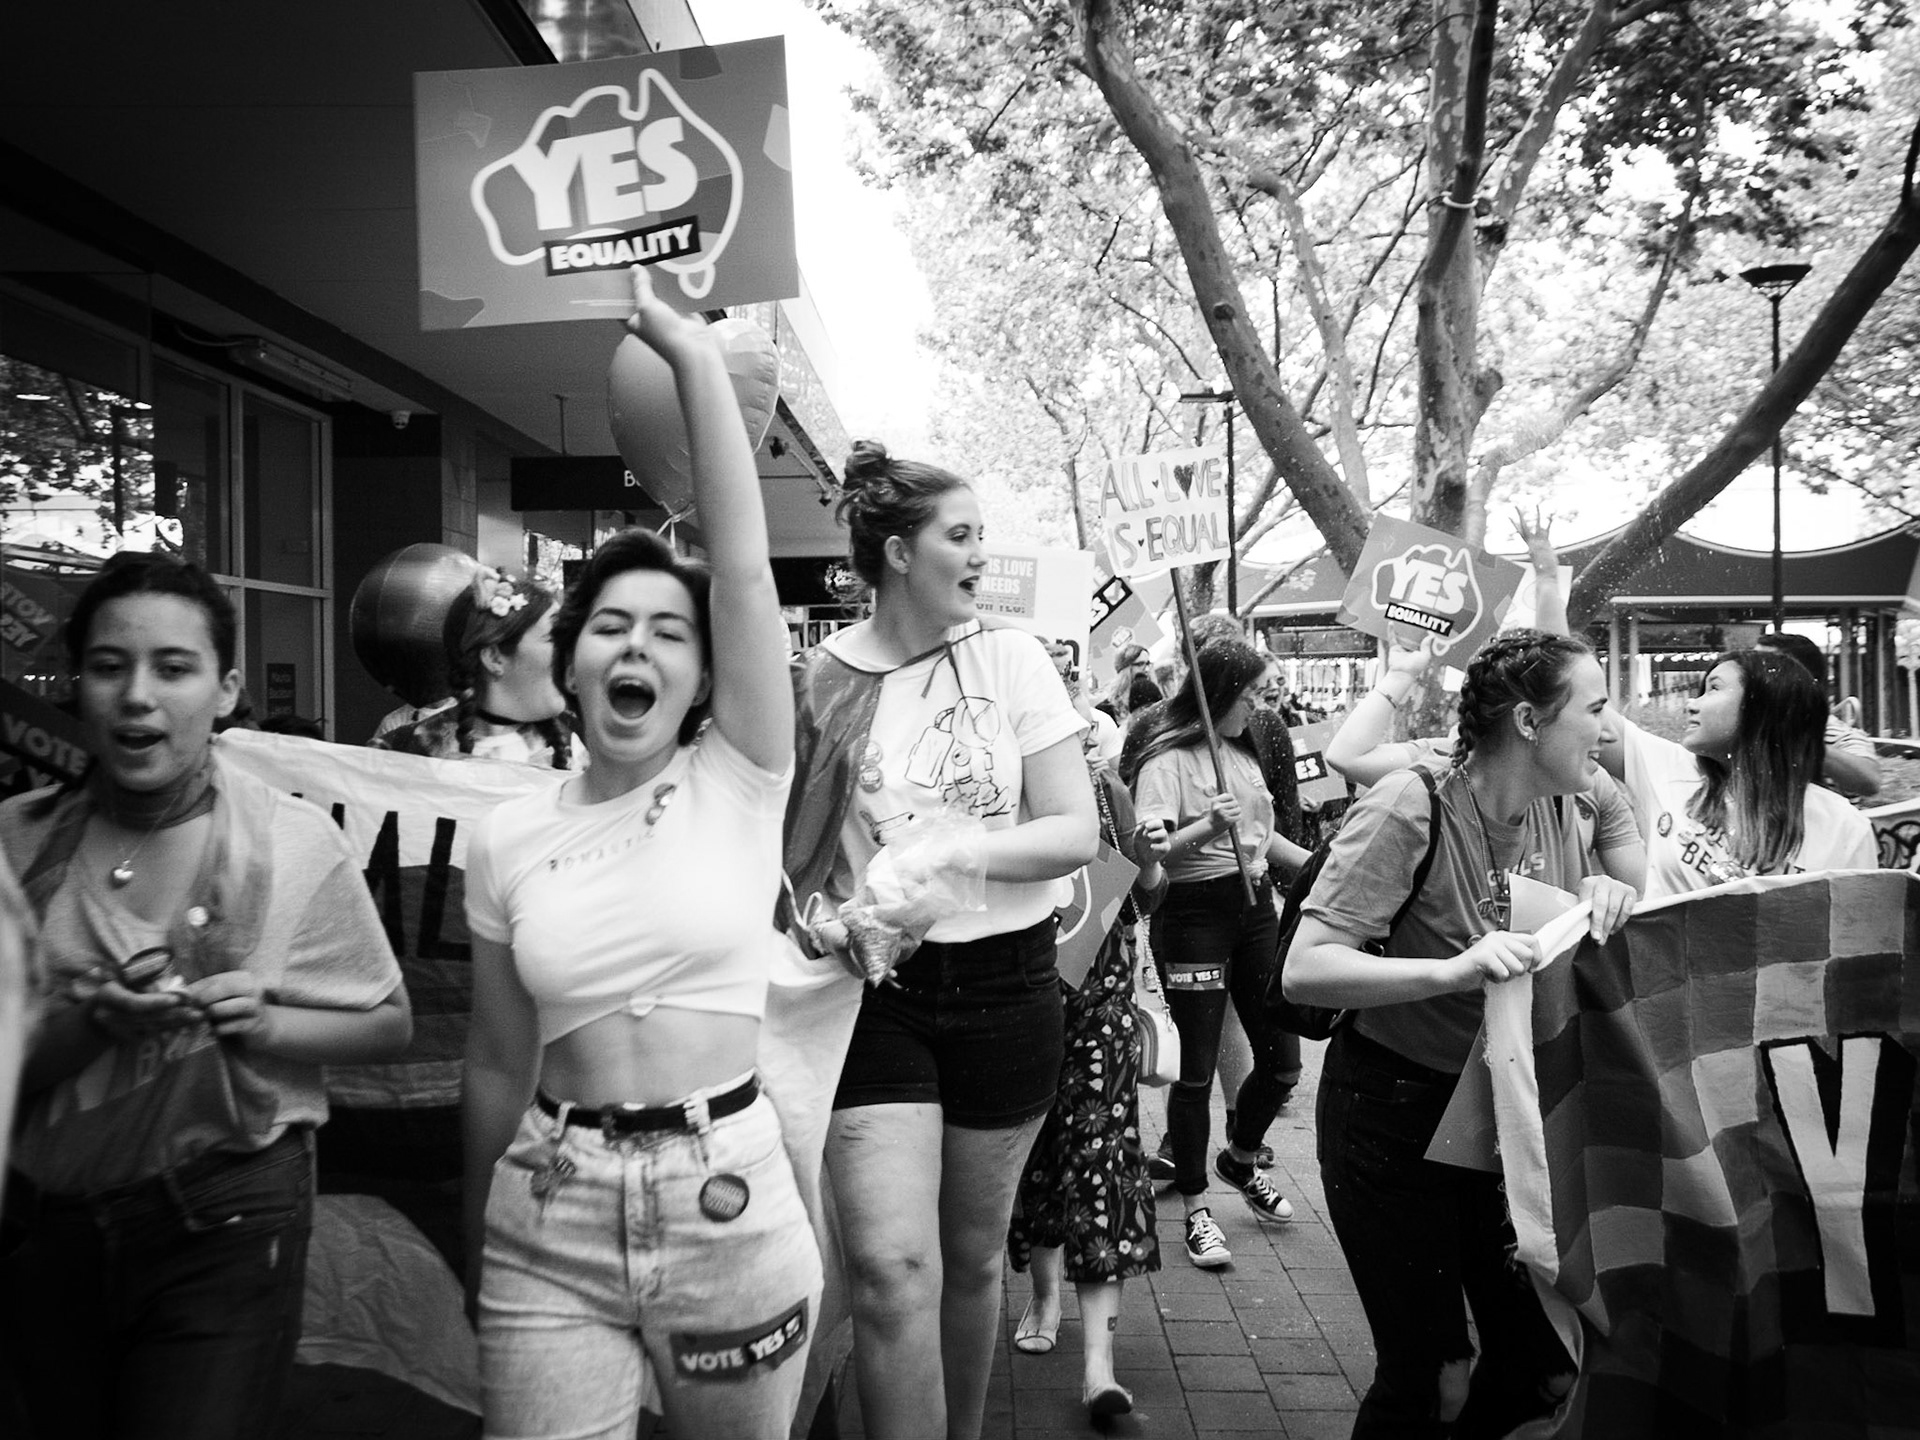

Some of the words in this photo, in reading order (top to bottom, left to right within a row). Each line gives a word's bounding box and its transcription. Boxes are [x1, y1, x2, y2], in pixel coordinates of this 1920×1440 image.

[512, 116, 698, 231] YES
[550, 223, 693, 270] EQUALITY
[1101, 463, 1155, 518] ALL
[1107, 522, 1138, 570] IS
[1146, 512, 1228, 561] EQUAL
[981, 575, 1020, 594] NEEDS
[1003, 559, 1034, 577] LOVE
[1389, 557, 1469, 614] YES
[1387, 605, 1451, 633] EQUALITY
[2, 711, 89, 776] VOTE
[1295, 757, 1320, 780] ES
[1169, 972, 1193, 983] VOTE
[680, 1347, 745, 1372] VOTE
[750, 1328, 786, 1361] YES
